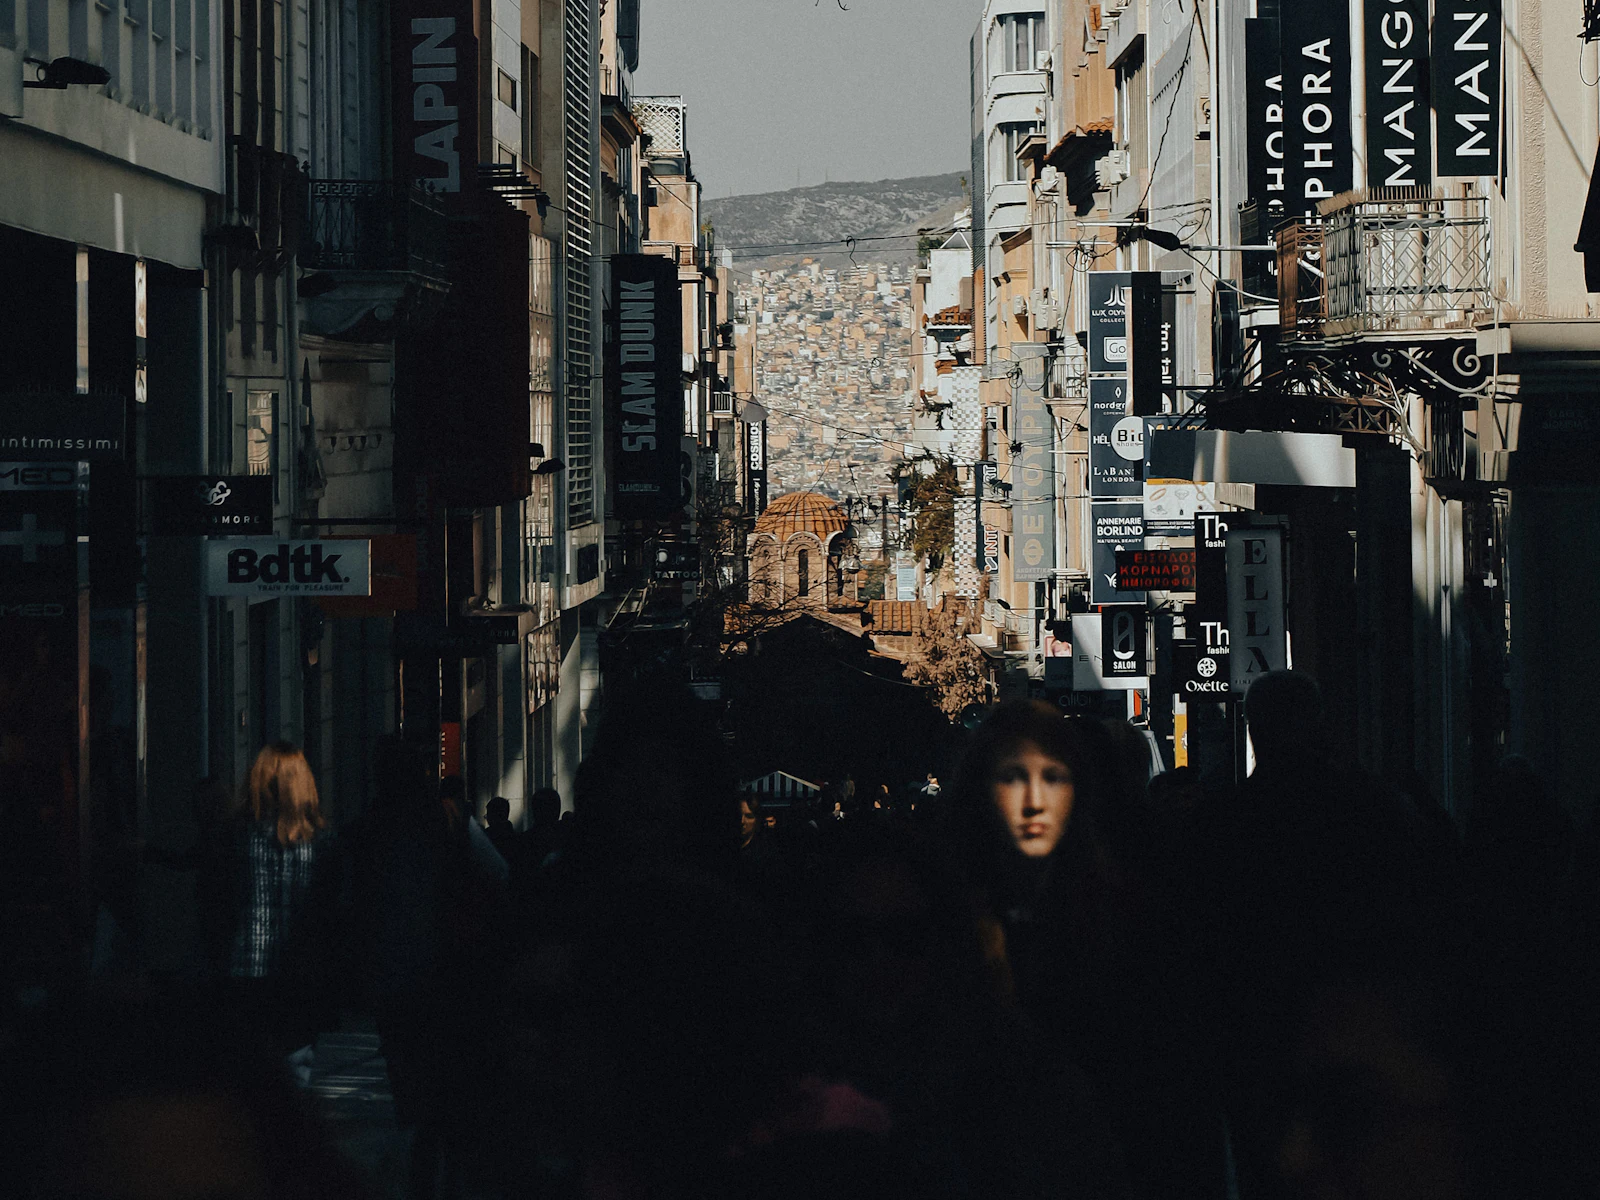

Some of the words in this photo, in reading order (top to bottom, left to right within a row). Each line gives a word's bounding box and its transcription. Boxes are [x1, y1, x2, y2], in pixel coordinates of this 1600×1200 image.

[411, 16, 460, 195] LAPIN
[619, 279, 656, 365] DUNK
[621, 370, 657, 453] SLAM
[1096, 516, 1142, 525] ANNEMARIE
[227, 543, 351, 583] Bdtk.
[654, 570, 698, 579] TATTOO
[1242, 538, 1272, 673] ELLA
[1112, 660, 1137, 670] SALON
[1184, 679, 1230, 693] Oxétte
